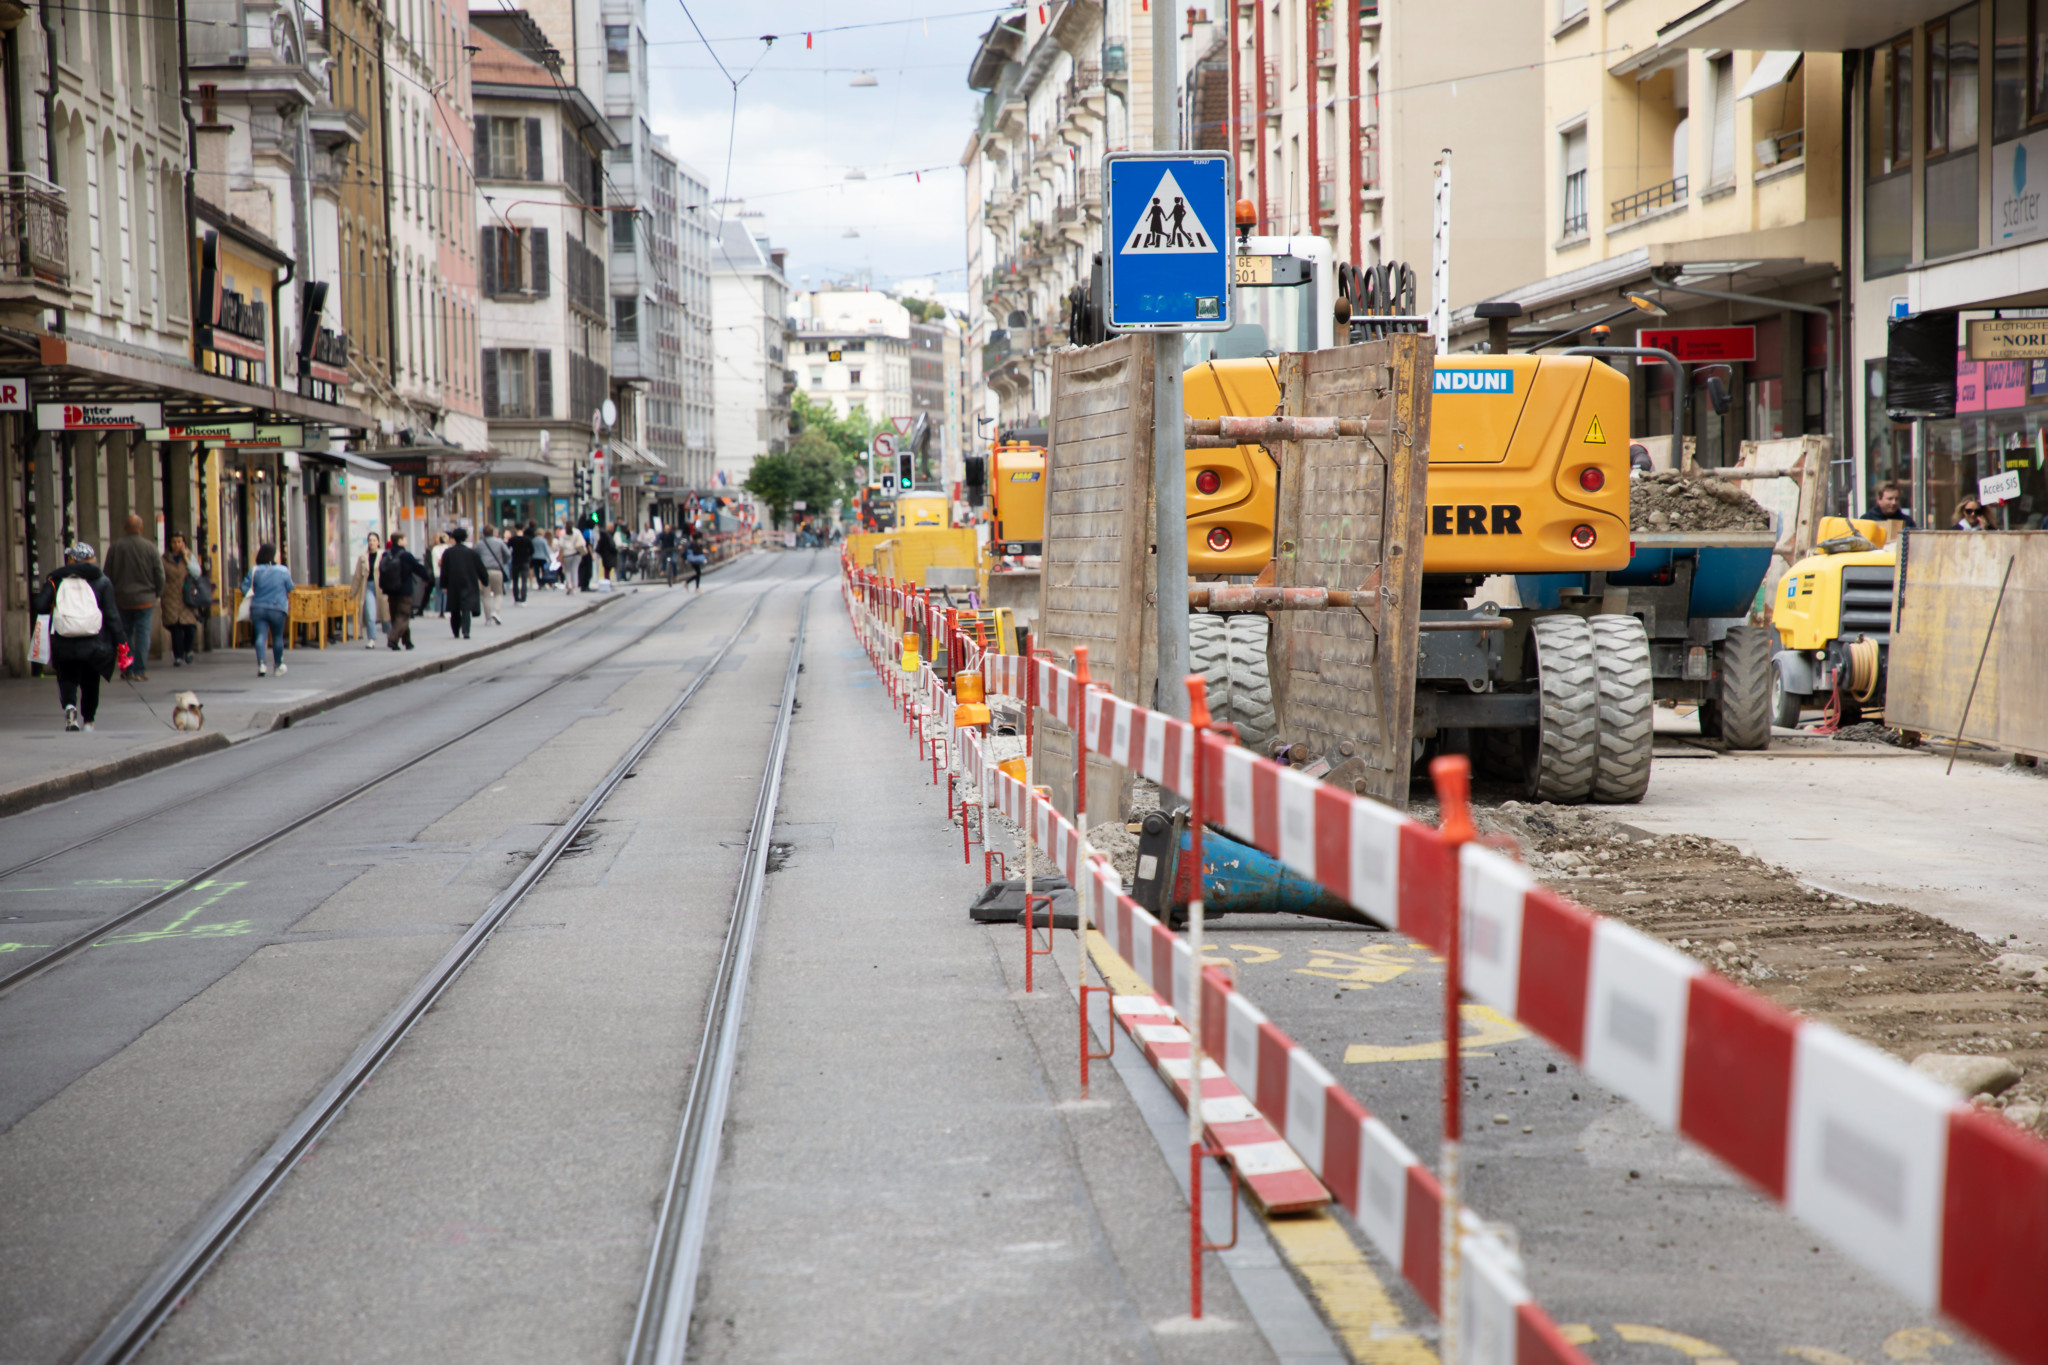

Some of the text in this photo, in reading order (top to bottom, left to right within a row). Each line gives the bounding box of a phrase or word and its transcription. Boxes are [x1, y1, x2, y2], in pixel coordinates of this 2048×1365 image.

[2003, 192, 2040, 228] starter
[1238, 257, 1252, 268] GE
[0, 385, 17, 404] R
[83, 406, 112, 415] Inter
[83, 415, 136, 424] Discount
[185, 427, 231, 435] Discount
[1983, 477, 2018, 496] Accès SIS
[1424, 504, 1523, 535] ERR
